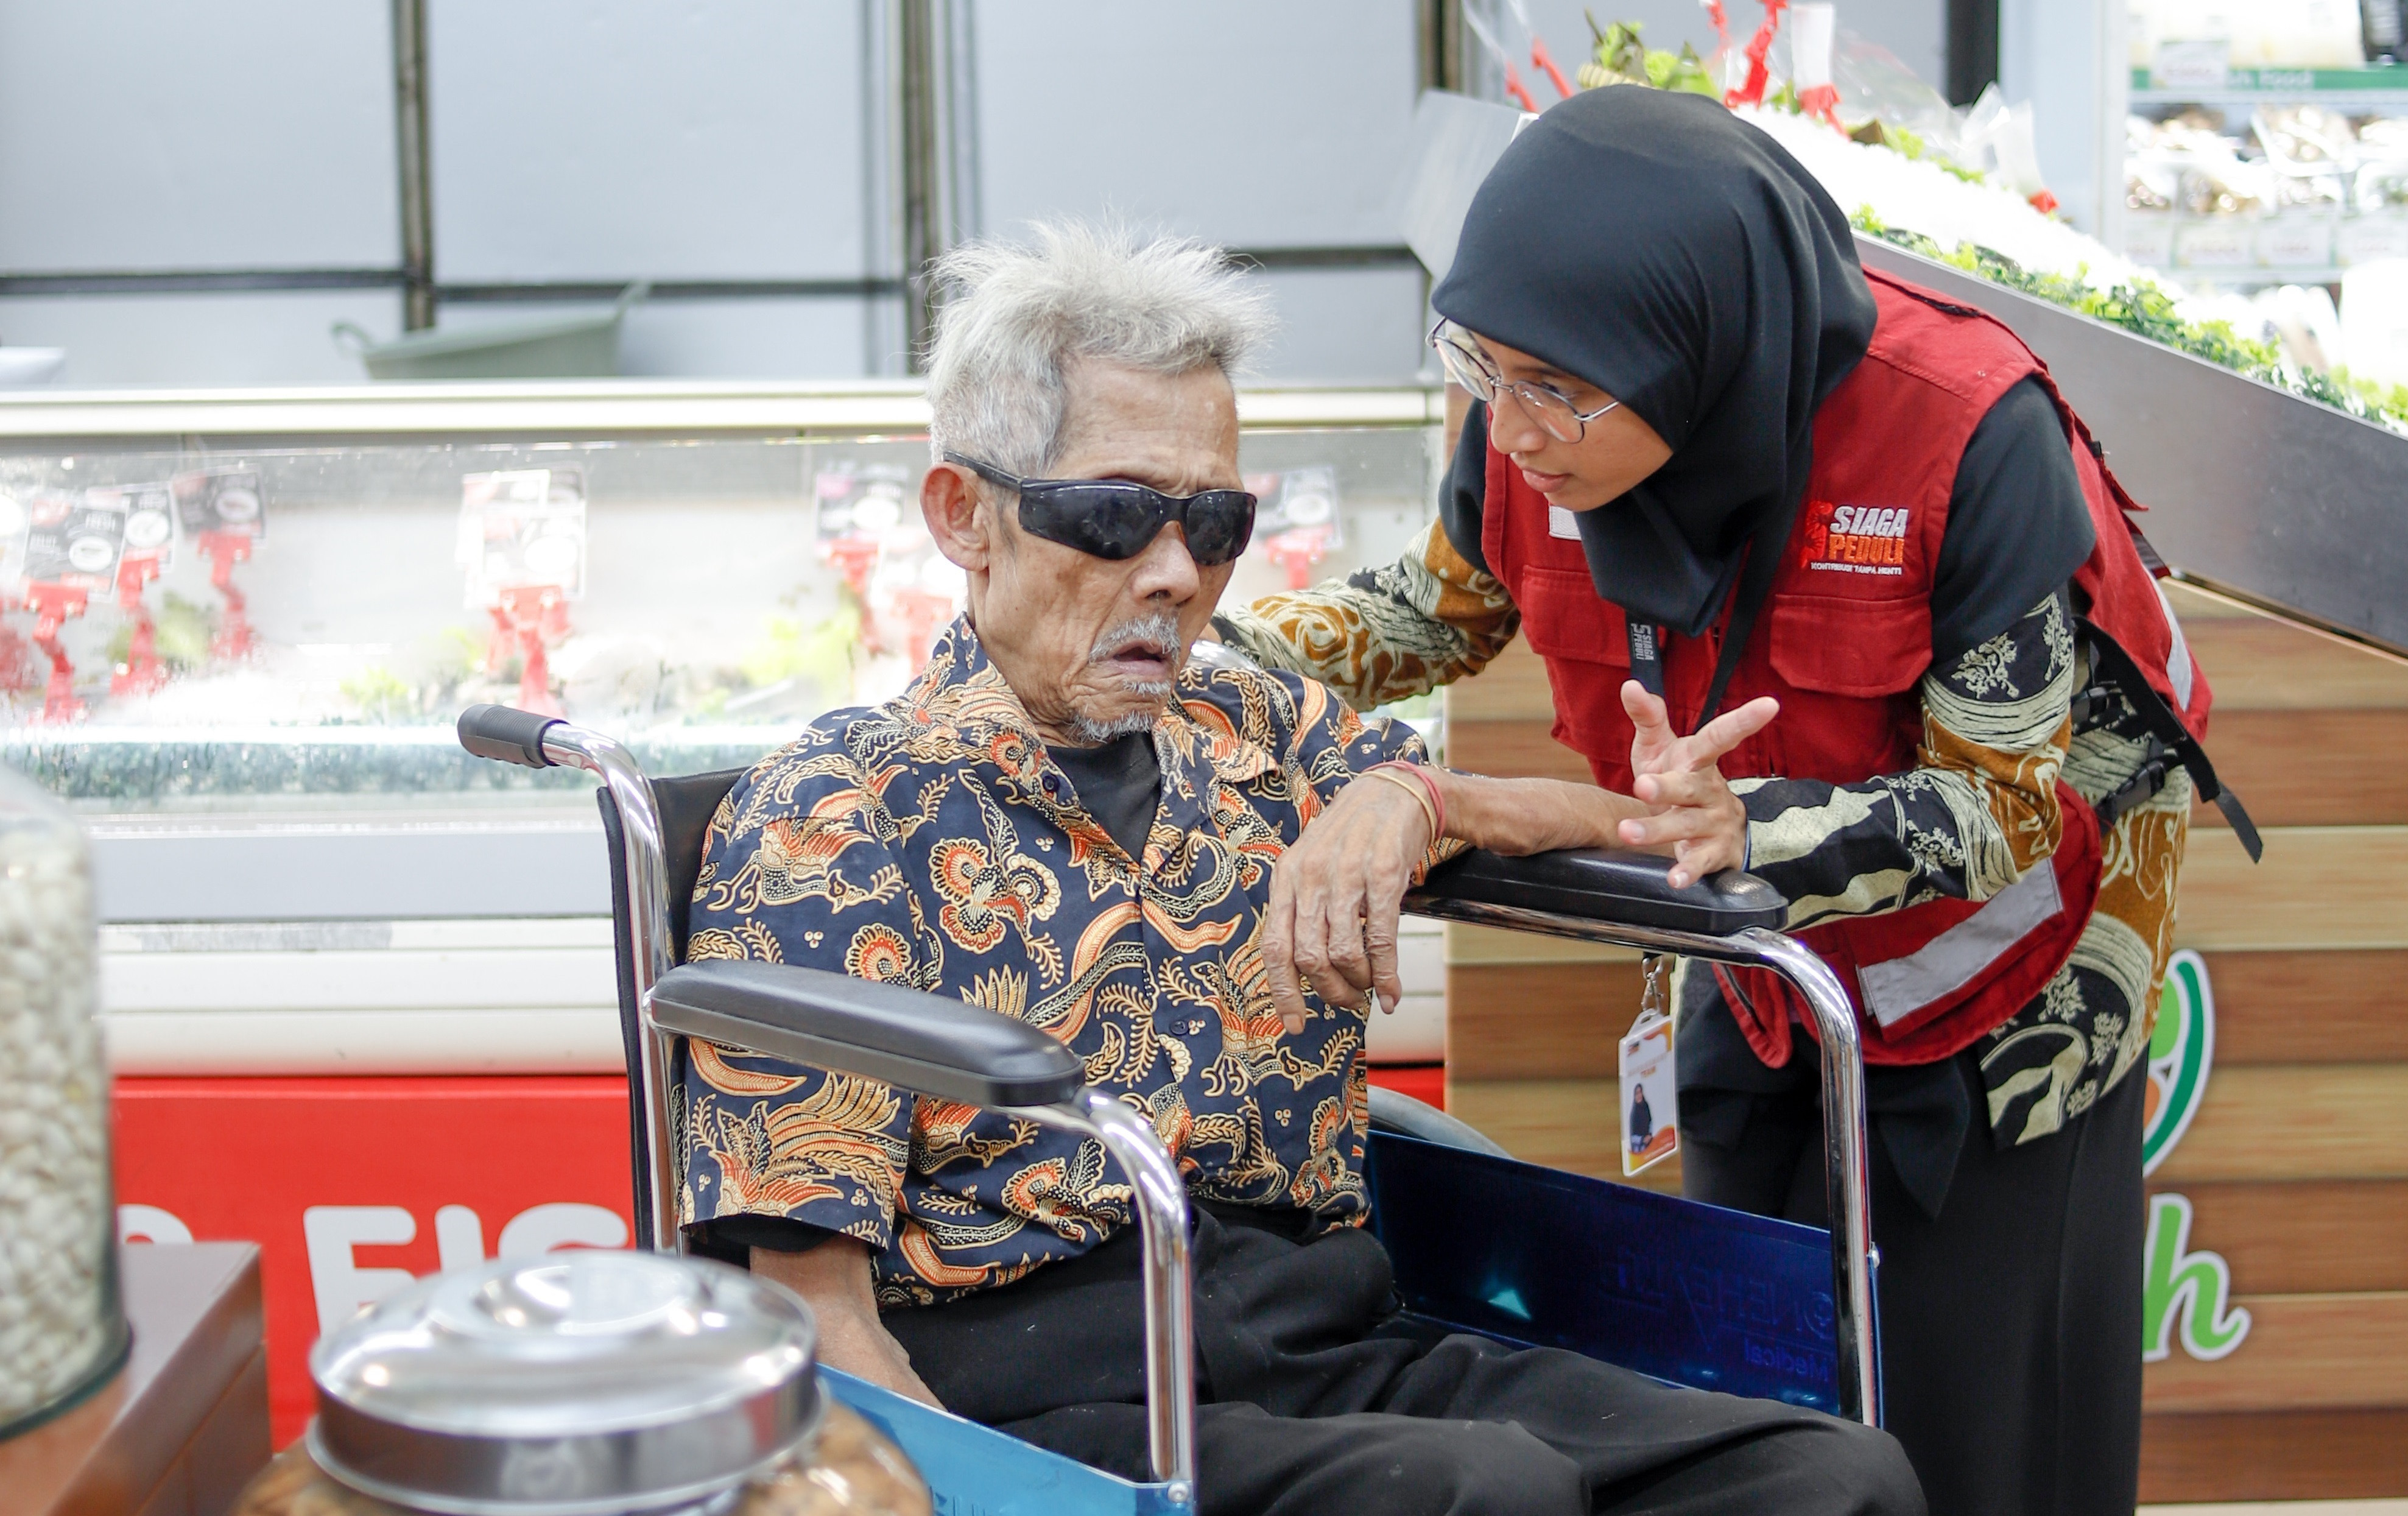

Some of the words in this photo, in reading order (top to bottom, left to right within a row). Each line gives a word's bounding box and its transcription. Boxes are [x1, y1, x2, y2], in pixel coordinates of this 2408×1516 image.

[1829, 506, 1909, 537] SIAGA
[1829, 534, 1905, 564] PEDULI
[1643, 635, 1654, 660] SIAGA
